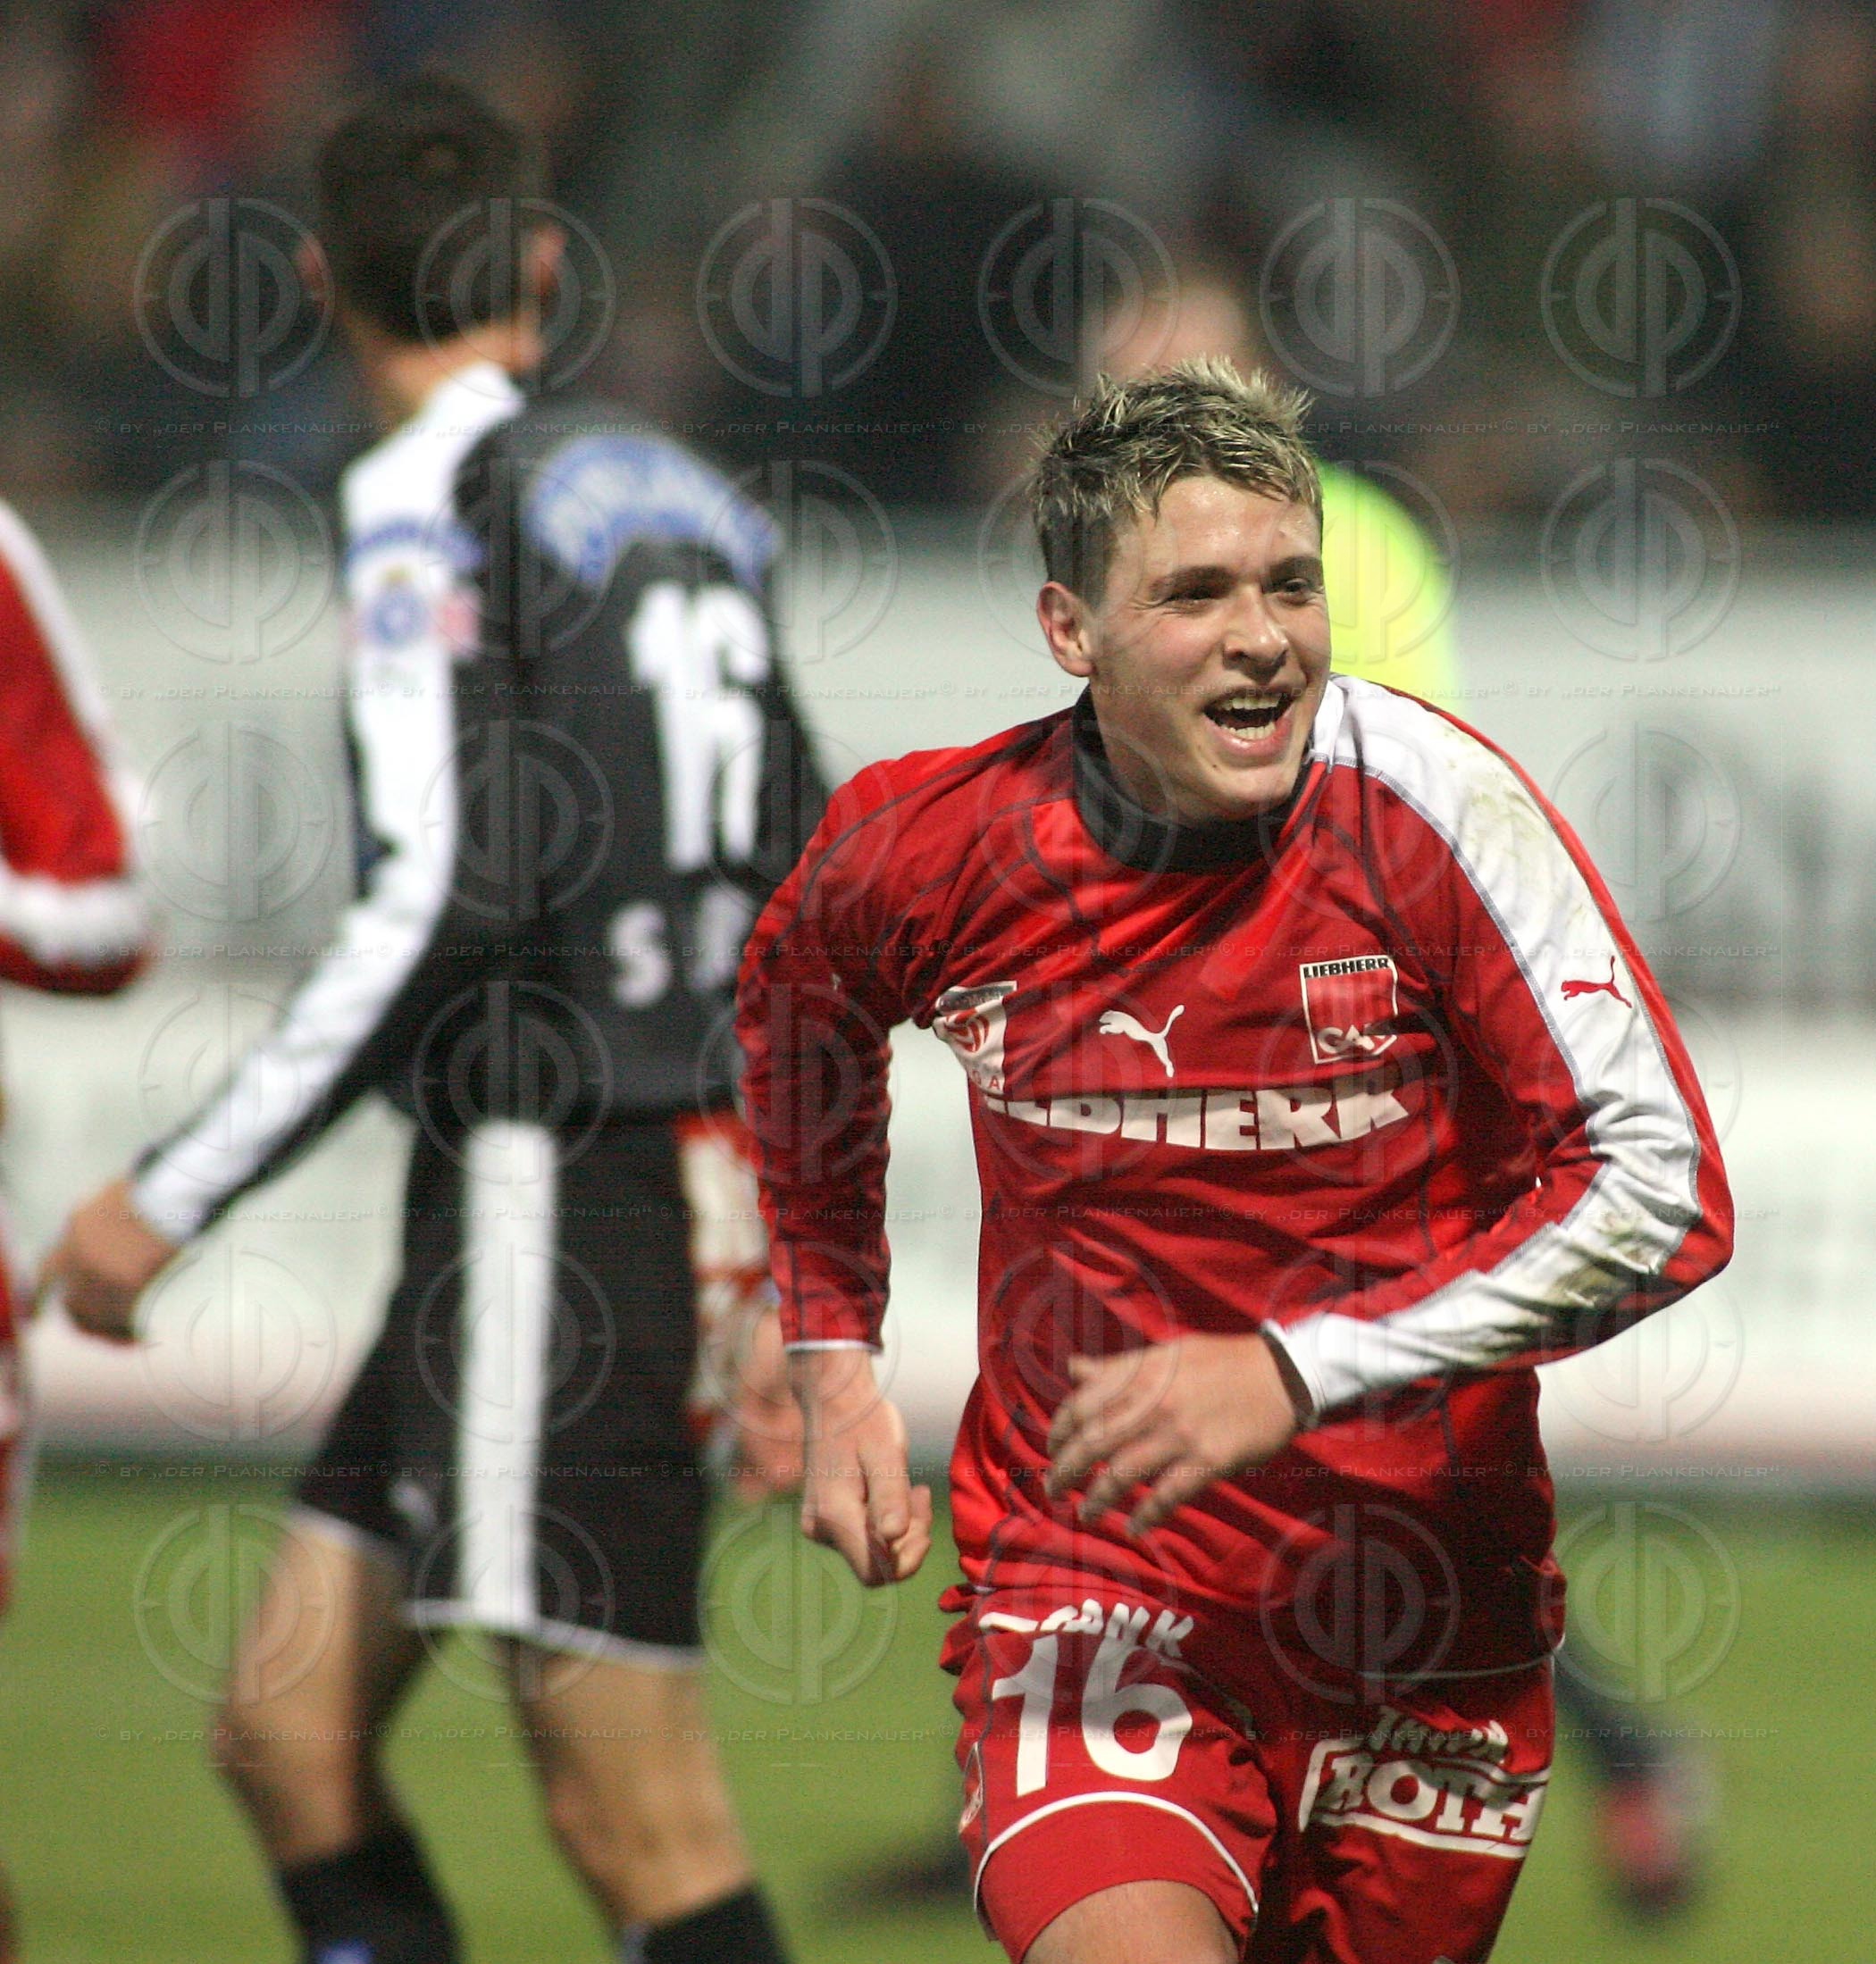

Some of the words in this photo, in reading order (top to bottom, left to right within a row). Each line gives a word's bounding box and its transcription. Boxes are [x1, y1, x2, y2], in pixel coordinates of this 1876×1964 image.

[1302, 957, 1390, 979] LIEBHERR
[992, 1634, 1193, 1798] 16
[1315, 1752, 1544, 1842] ROTH
